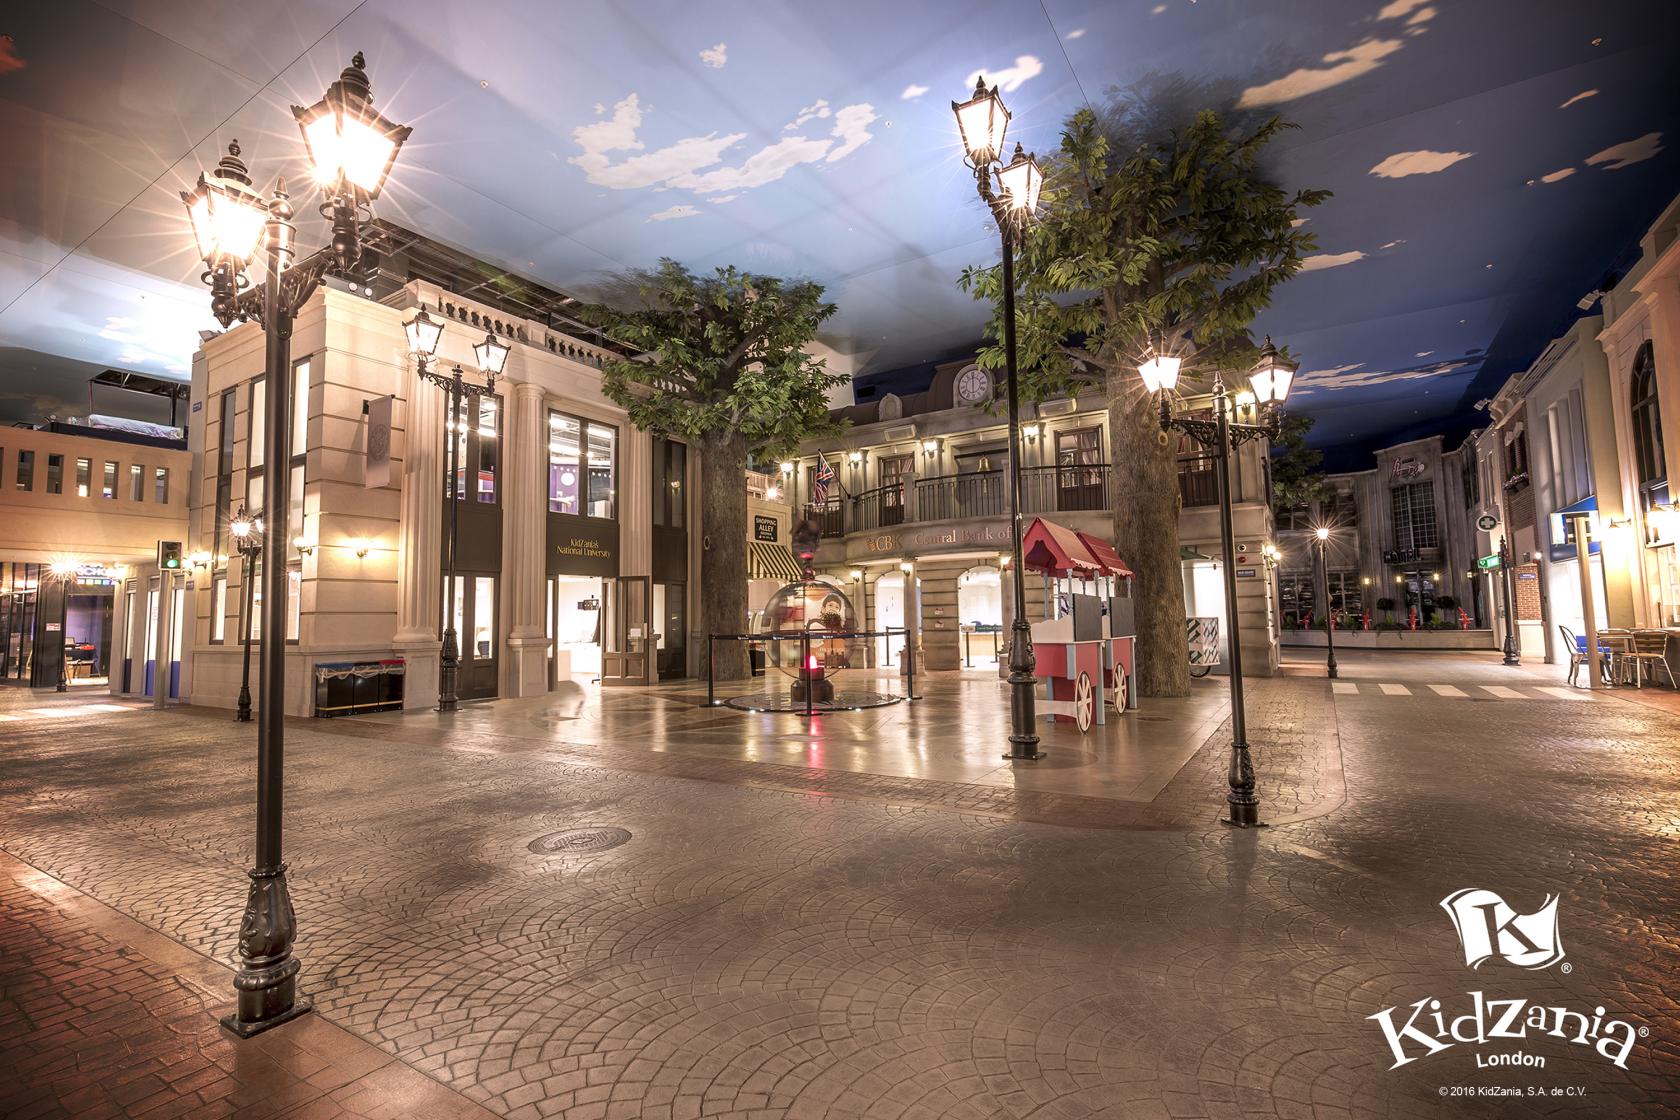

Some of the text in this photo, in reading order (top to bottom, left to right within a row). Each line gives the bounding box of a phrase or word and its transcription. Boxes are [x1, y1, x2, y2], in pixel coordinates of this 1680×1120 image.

[759, 524, 775, 532] ALLEY
[915, 530, 956, 545] Central
[962, 527, 994, 541] Bank
[556, 545, 611, 560] National University
